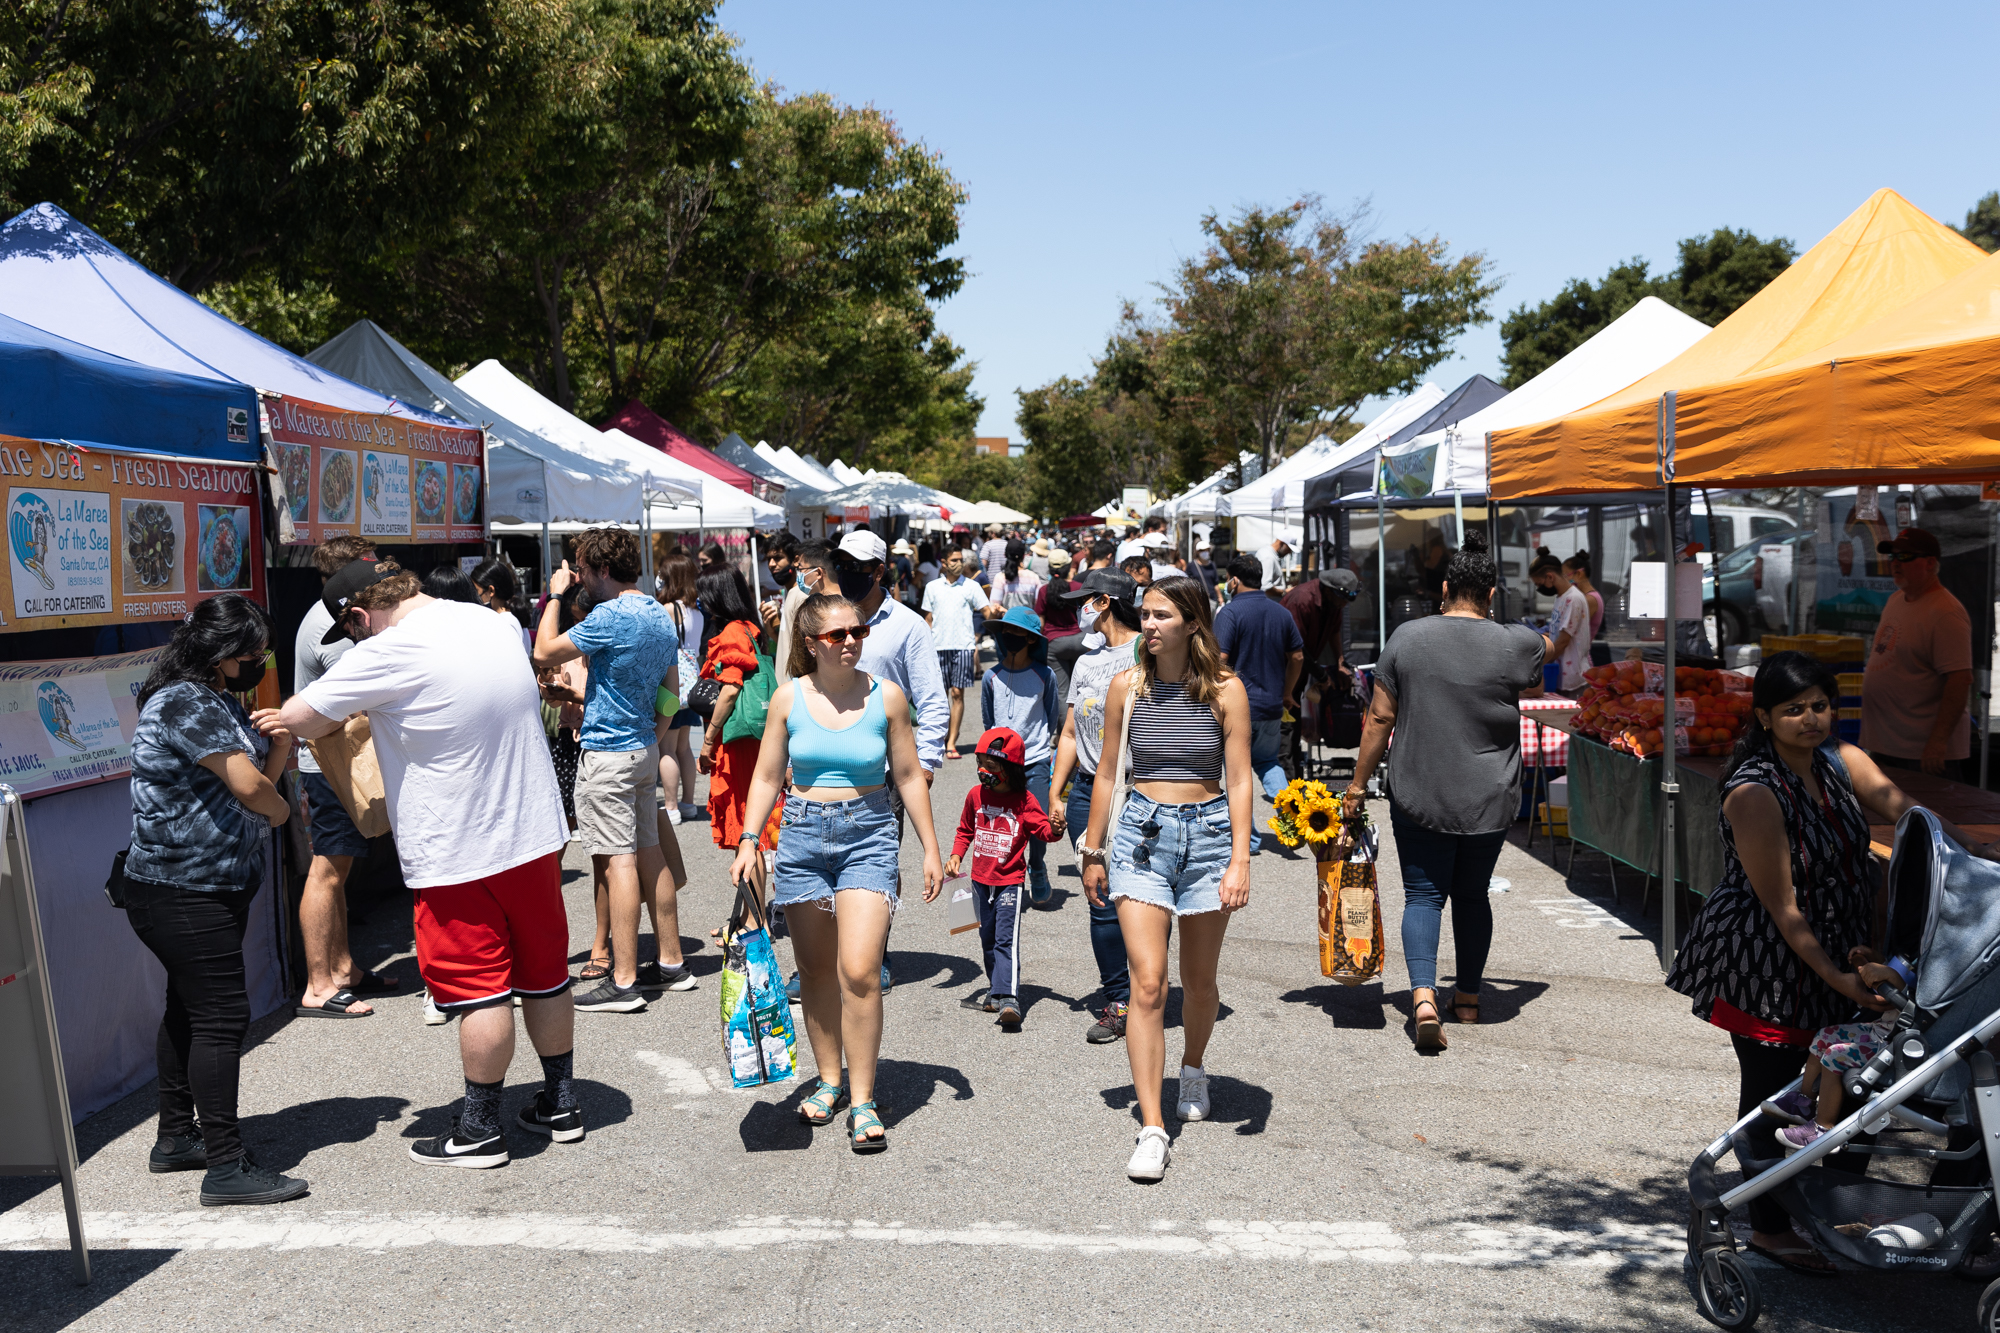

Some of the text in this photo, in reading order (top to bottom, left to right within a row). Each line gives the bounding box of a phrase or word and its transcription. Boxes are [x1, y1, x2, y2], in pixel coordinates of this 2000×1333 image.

[284, 401, 332, 440] Marea
[331, 412, 350, 440] of
[349, 411, 373, 444] the
[373, 417, 396, 447] Sea
[406, 423, 438, 454] Fresh
[440, 428, 481, 458] Seafood
[40, 440, 85, 481] Sea
[111, 454, 172, 487] Fresh
[178, 463, 253, 495] Seafood
[383, 458, 409, 476] La Marea
[58, 499, 108, 524] La Marea
[323, 529, 335, 541] FISH
[363, 524, 408, 533] CALL FOR CATERING
[58, 530, 109, 551] of the Sea
[60, 556, 110, 573] Santa Cruz, CA
[25, 595, 106, 614] CALL FOR CATERING
[123, 601, 187, 617] FRESH OYSTERS
[12, 753, 47, 772] SAUCE,
[81, 753, 91, 761] FOR
[92, 748, 117, 760] CATERING
[52, 768, 74, 782] FRESH
[74, 762, 110, 779] HOMEMADE
[756, 1013, 772, 1021] SOUTH
